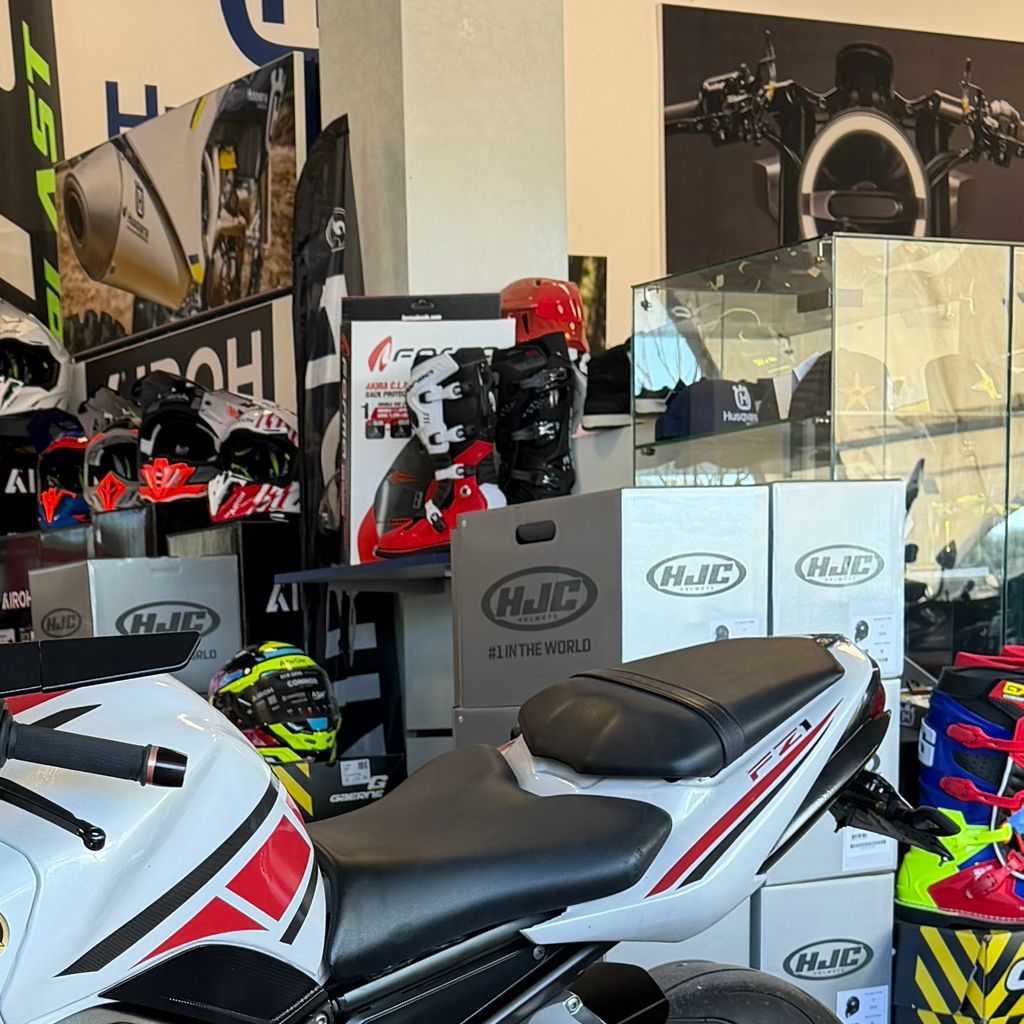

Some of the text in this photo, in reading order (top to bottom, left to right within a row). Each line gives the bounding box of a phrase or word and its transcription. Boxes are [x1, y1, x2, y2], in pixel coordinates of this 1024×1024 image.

[659, 561, 736, 588] HJC
[806, 553, 874, 579] HJC
[495, 579, 582, 618] HJC
[46, 615, 77, 629] HJC
[130, 610, 208, 633] HJC
[488, 638, 591, 661] #1 IN THE WORLD
[748, 719, 812, 782] FZ1
[795, 946, 863, 973] HJC
